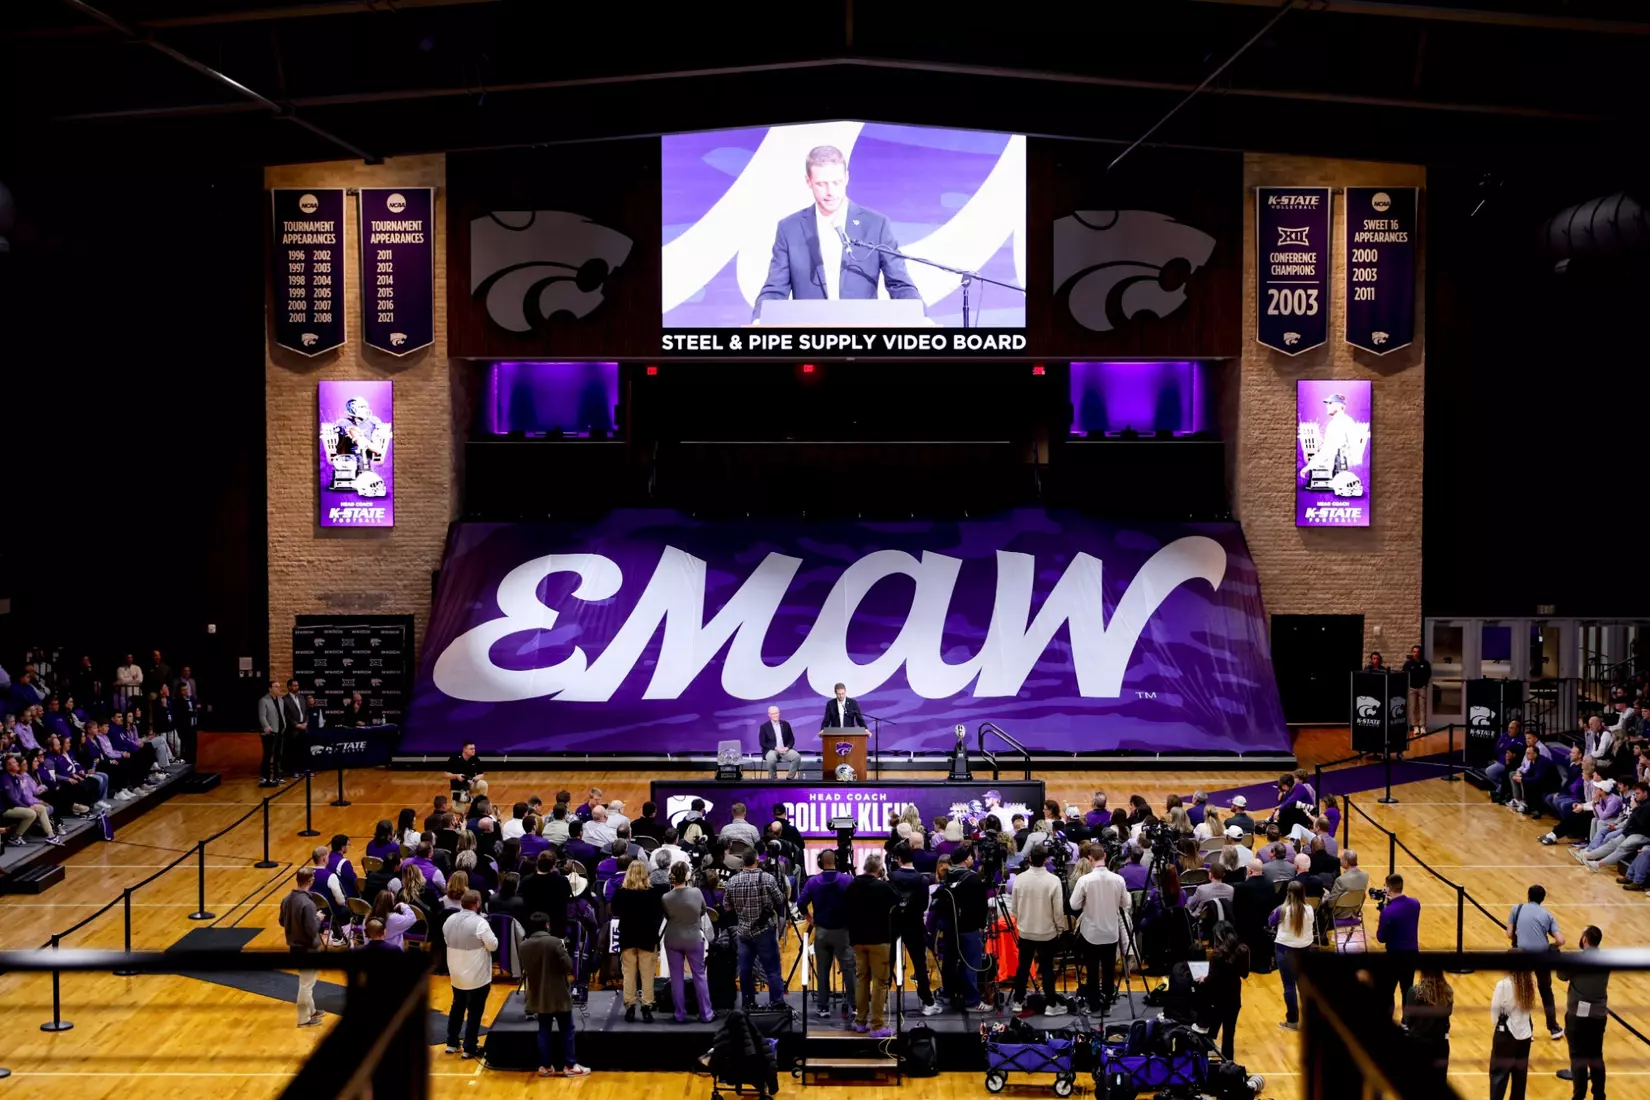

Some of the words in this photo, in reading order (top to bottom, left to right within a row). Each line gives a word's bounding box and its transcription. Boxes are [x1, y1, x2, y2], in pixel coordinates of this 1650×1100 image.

[1268, 196, 1320, 205] K-STATE
[284, 221, 334, 232] TOURNAMENT
[372, 221, 422, 231] TOURNAMENT
[1364, 219, 1388, 229] SWEET
[1390, 219, 1398, 229] 16
[283, 234, 336, 244] APPEARANCES
[370, 233, 424, 244] APPEARANCES
[1354, 232, 1408, 242] APPEARANCES
[288, 251, 305, 260] 1996
[313, 251, 331, 260] 2002
[377, 250, 392, 260] 2011
[1270, 253, 1316, 263] CONFERENCE
[1352, 249, 1378, 262] 2000
[289, 263, 304, 273] 1997
[313, 263, 331, 273] 2003
[377, 263, 393, 272] 2012
[1271, 265, 1315, 275] CHAMPIONS
[377, 275, 393, 284] 2014
[1352, 268, 1377, 281] 2003
[289, 276, 305, 285] 1998
[313, 276, 331, 285] 2004
[289, 288, 305, 298] 1999
[313, 288, 331, 298] 2005
[377, 288, 393, 297] 2015
[1354, 287, 1375, 300] 2011
[288, 301, 306, 310] 2000
[314, 301, 331, 310] 2007
[377, 300, 394, 310] 2016
[1267, 289, 1318, 316] 2003
[289, 313, 306, 322] 2001
[314, 313, 332, 322] 2008
[378, 313, 393, 322] 2021
[661, 334, 723, 350] STEEL
[729, 334, 742, 350] &
[749, 334, 793, 350] PIPE
[799, 334, 877, 350] SUPPLY
[882, 334, 947, 350] VIDEO
[953, 334, 1026, 350] BOARD
[329, 508, 385, 518] K-STATE
[1305, 508, 1362, 518] K-STATE
